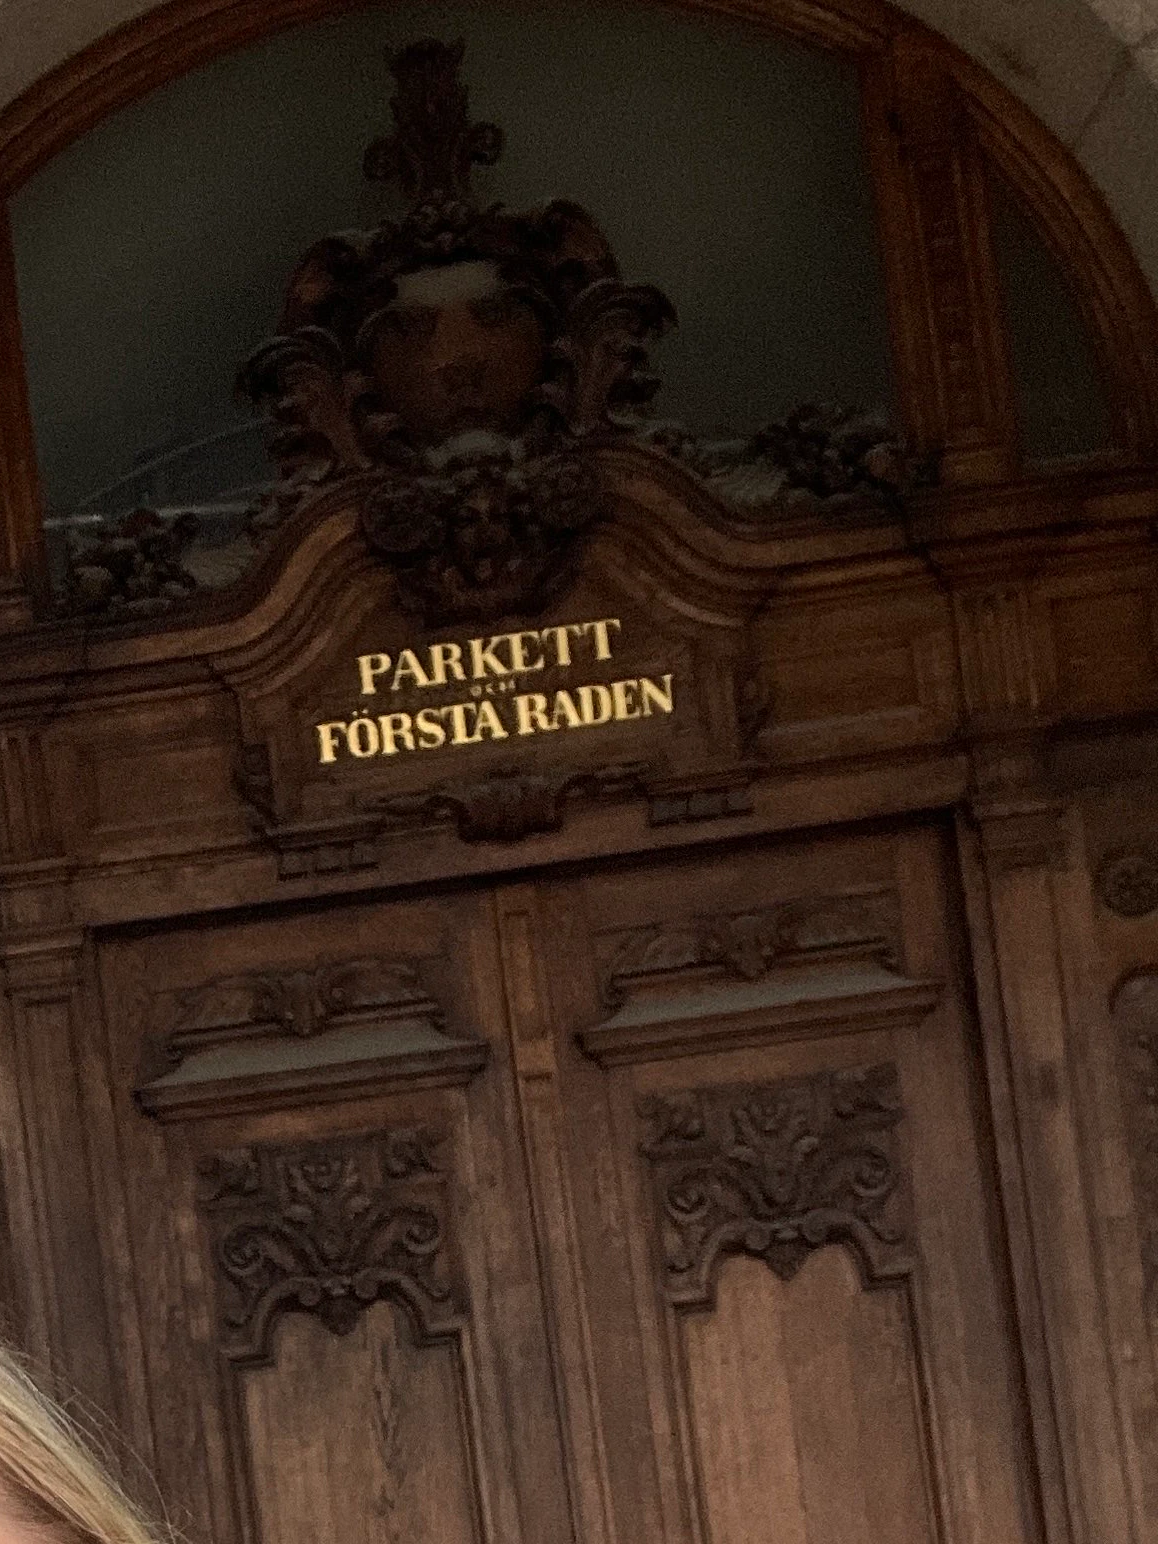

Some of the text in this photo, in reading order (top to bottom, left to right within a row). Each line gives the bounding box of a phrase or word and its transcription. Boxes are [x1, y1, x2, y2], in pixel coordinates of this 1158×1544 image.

[357, 618, 621, 695] PARKETT
[317, 674, 674, 763] FÖRSTA RADEN
